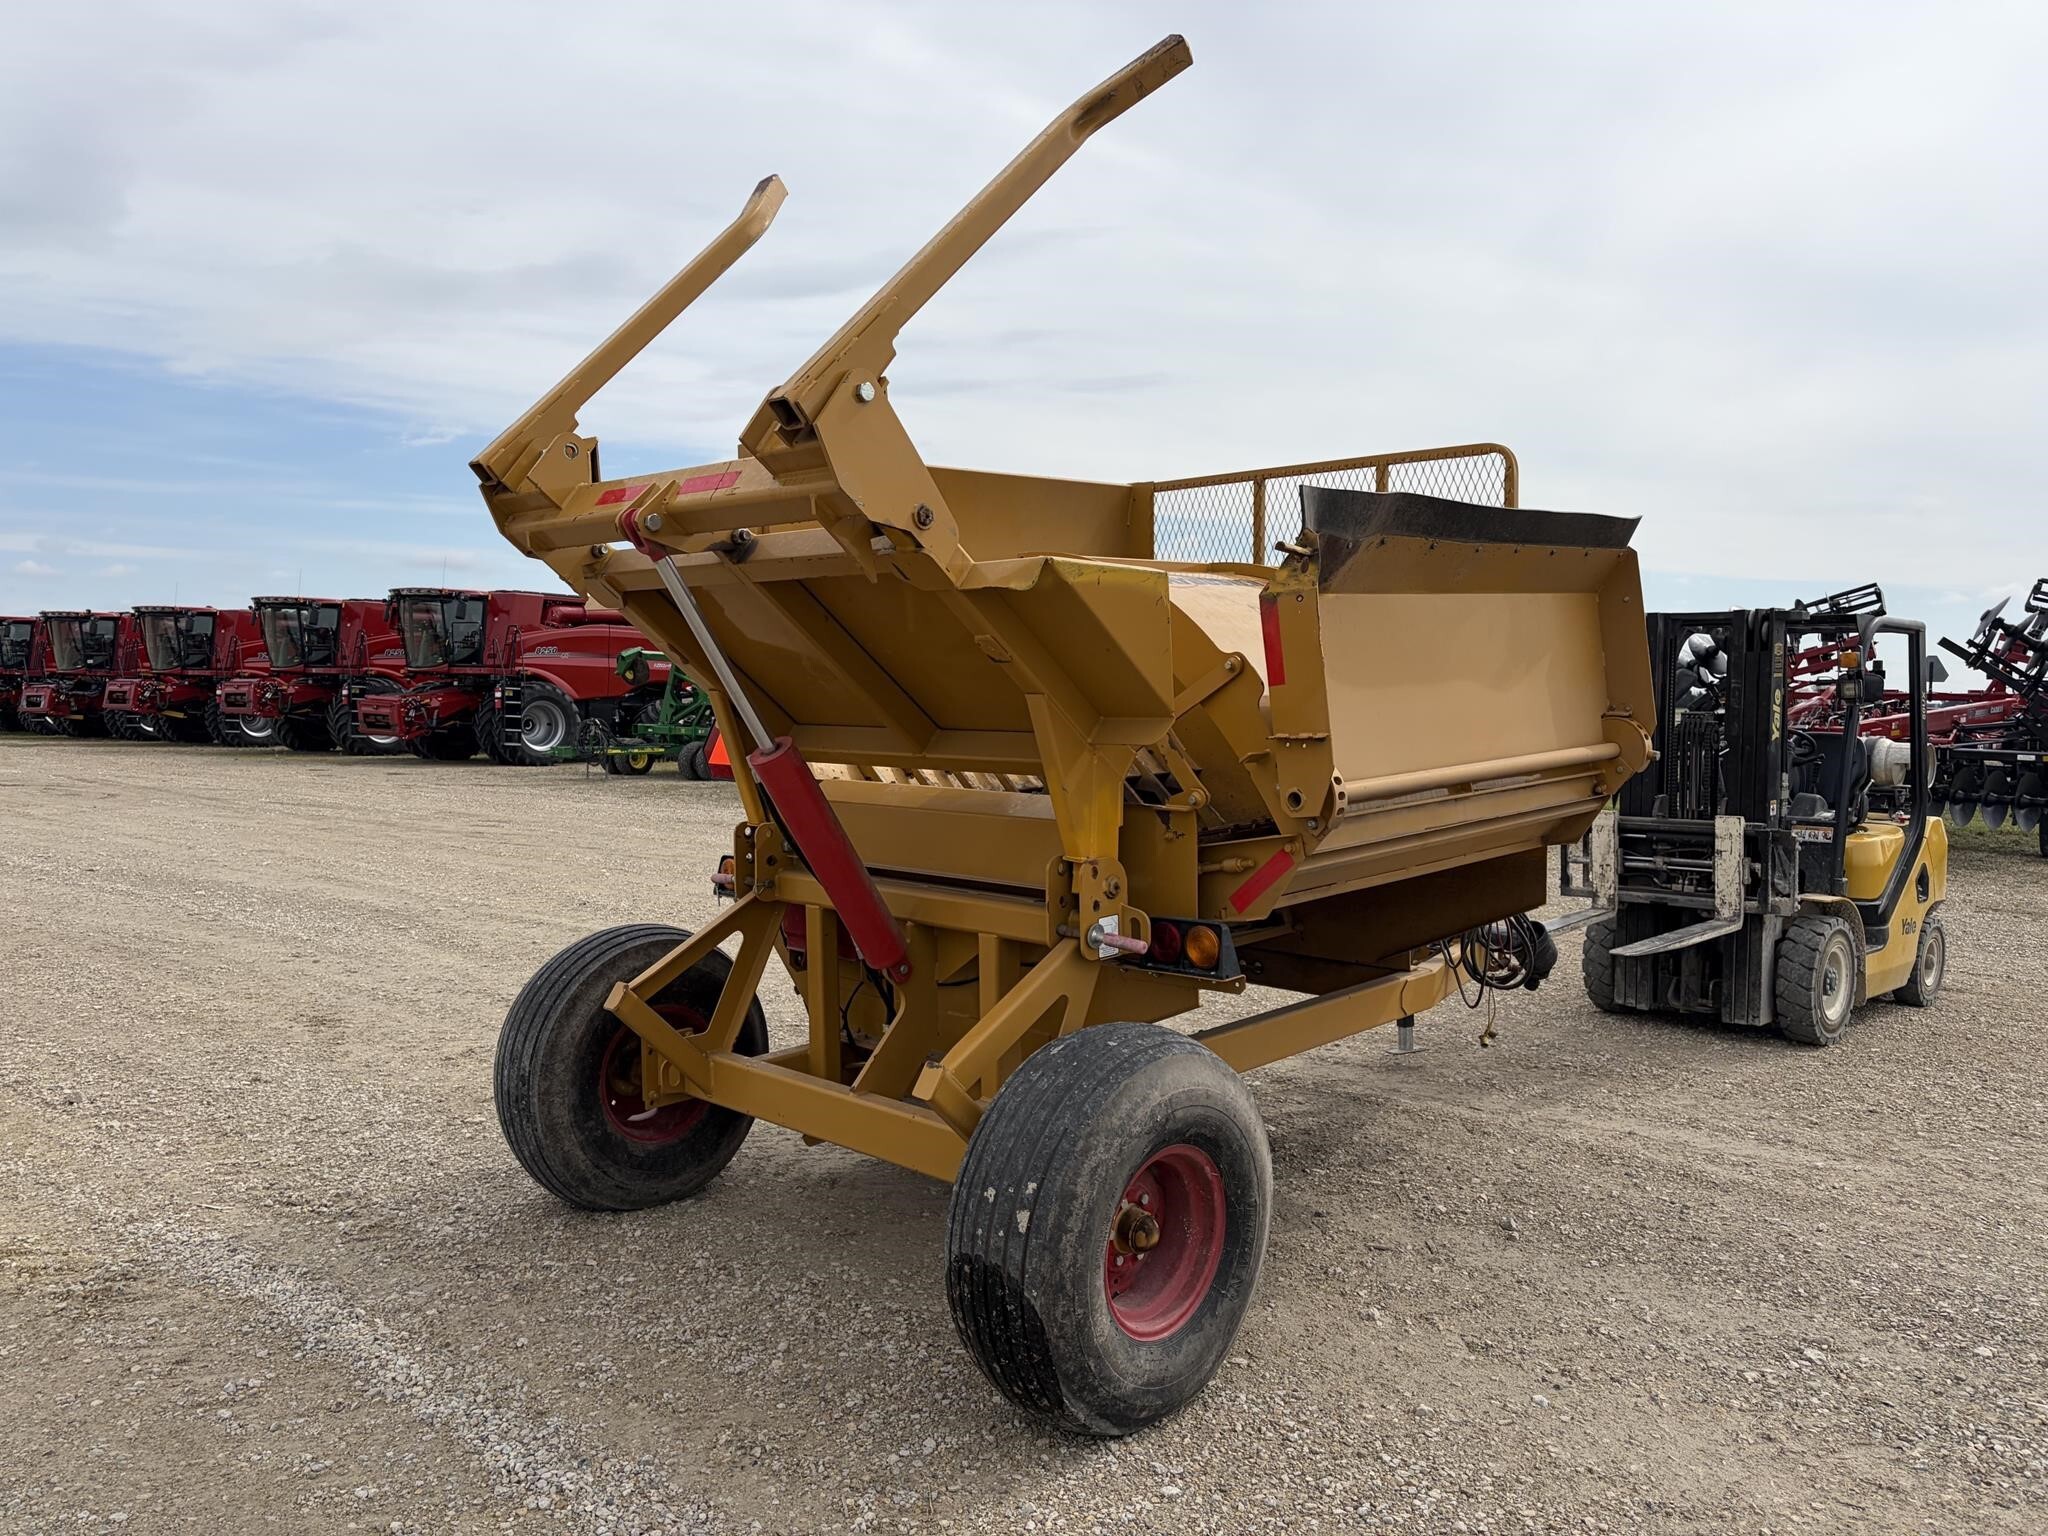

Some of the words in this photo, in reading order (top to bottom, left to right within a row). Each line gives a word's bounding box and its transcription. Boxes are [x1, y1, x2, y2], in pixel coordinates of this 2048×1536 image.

[535, 646, 558, 655] 8250
[1771, 688, 1781, 742] Yale
[1902, 917, 1917, 936] Yale
